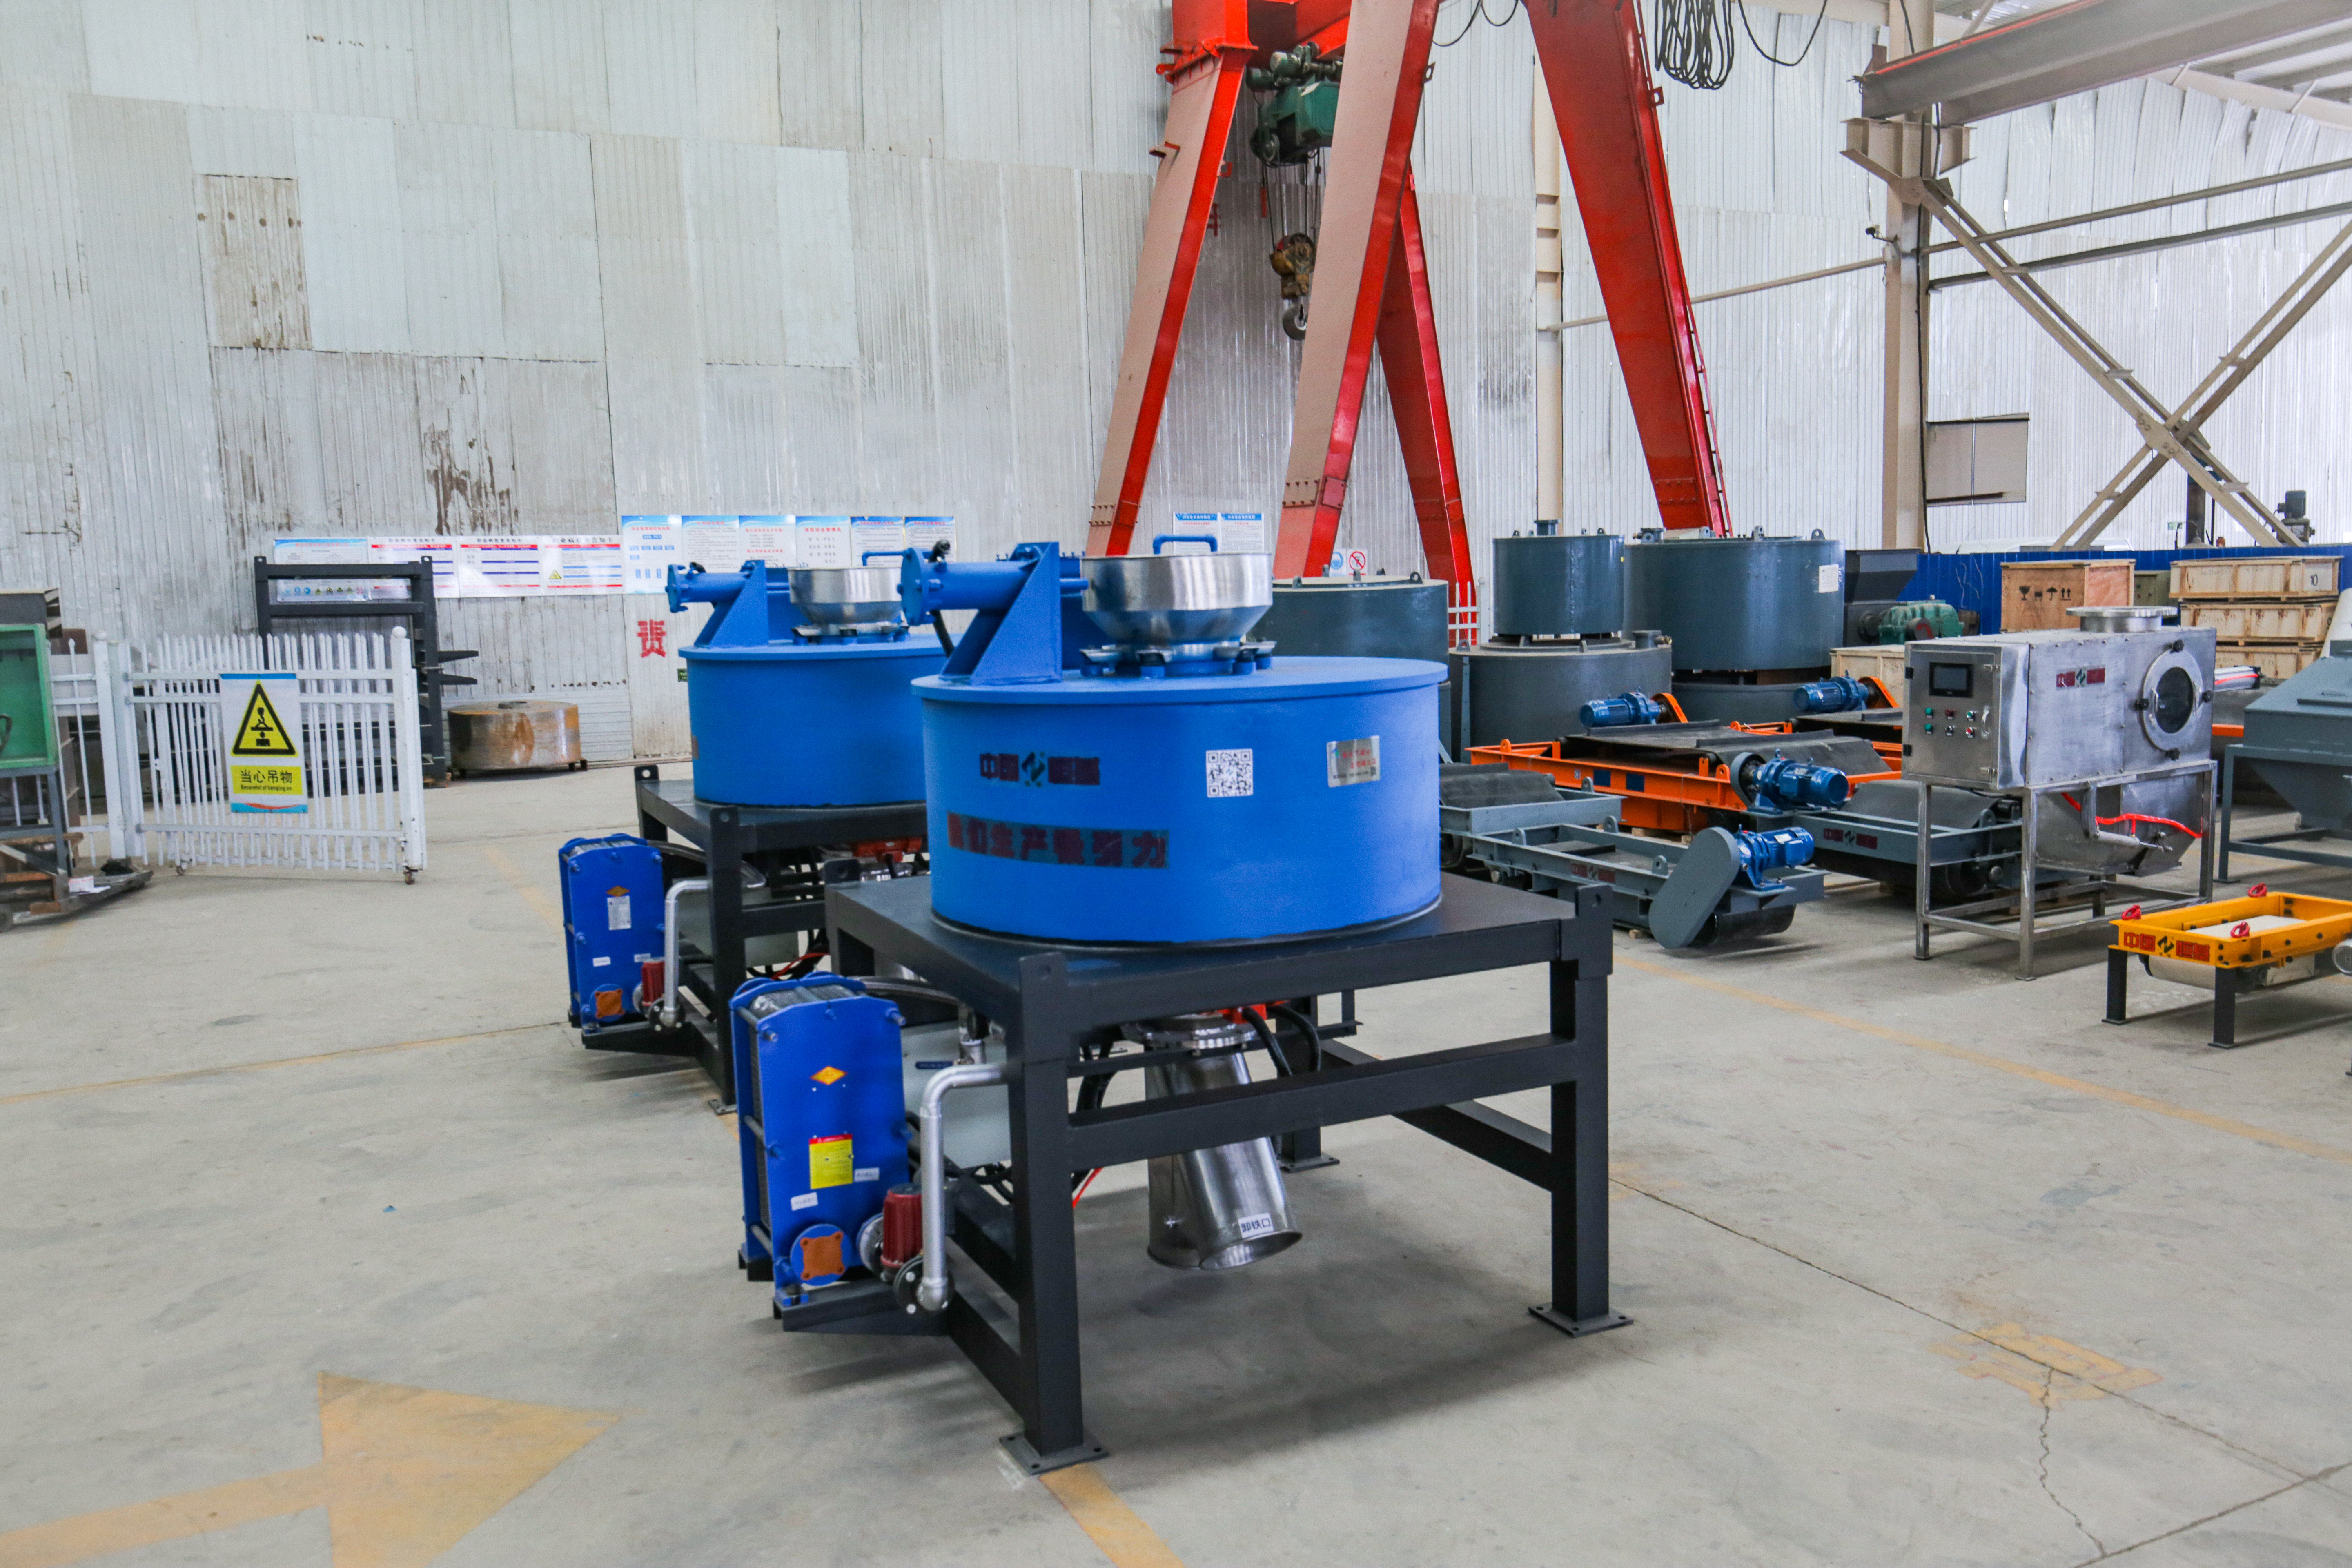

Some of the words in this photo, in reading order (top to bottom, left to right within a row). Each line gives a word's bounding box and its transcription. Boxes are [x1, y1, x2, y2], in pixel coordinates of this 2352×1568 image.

[2310, 573, 2319, 586] 10
[637, 619, 667, 658] 责
[240, 769, 292, 784] 当心吊物
[2124, 932, 2156, 952] 中国
